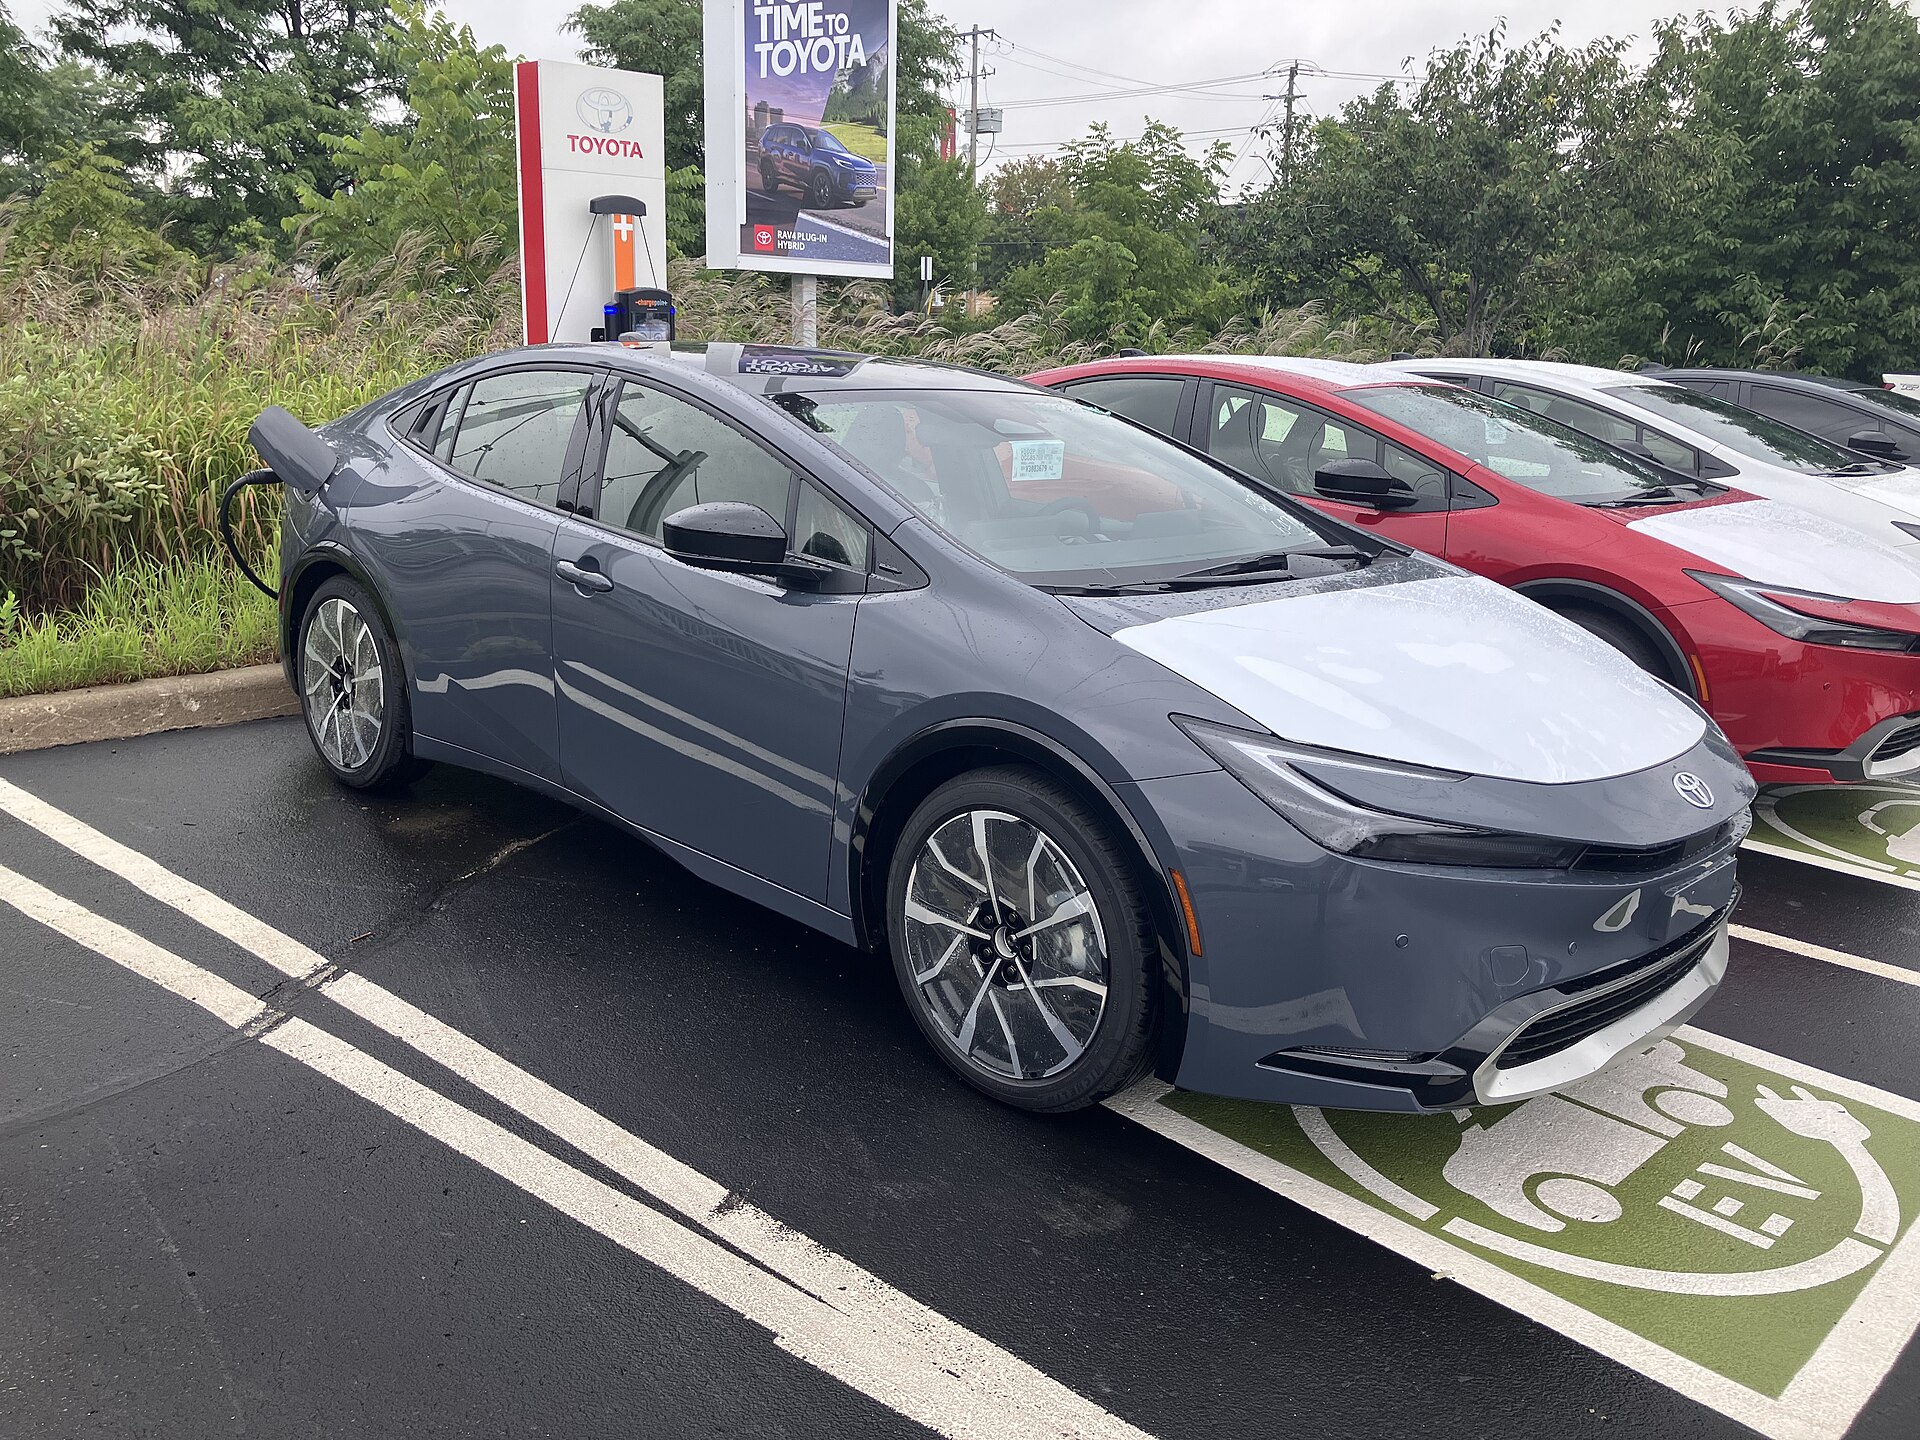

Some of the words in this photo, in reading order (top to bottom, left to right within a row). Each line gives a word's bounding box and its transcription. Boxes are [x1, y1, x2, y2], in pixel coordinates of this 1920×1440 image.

[754, 1, 824, 42] TIME
[825, 13, 850, 35] TO
[754, 33, 867, 79] TOYOTA
[566, 134, 644, 159] TOYOTA
[777, 229, 796, 241] RAV4
[796, 232, 828, 243] PLUG-IN
[777, 239, 805, 251] HYBRID
[1657, 1141, 1822, 1250] EV
